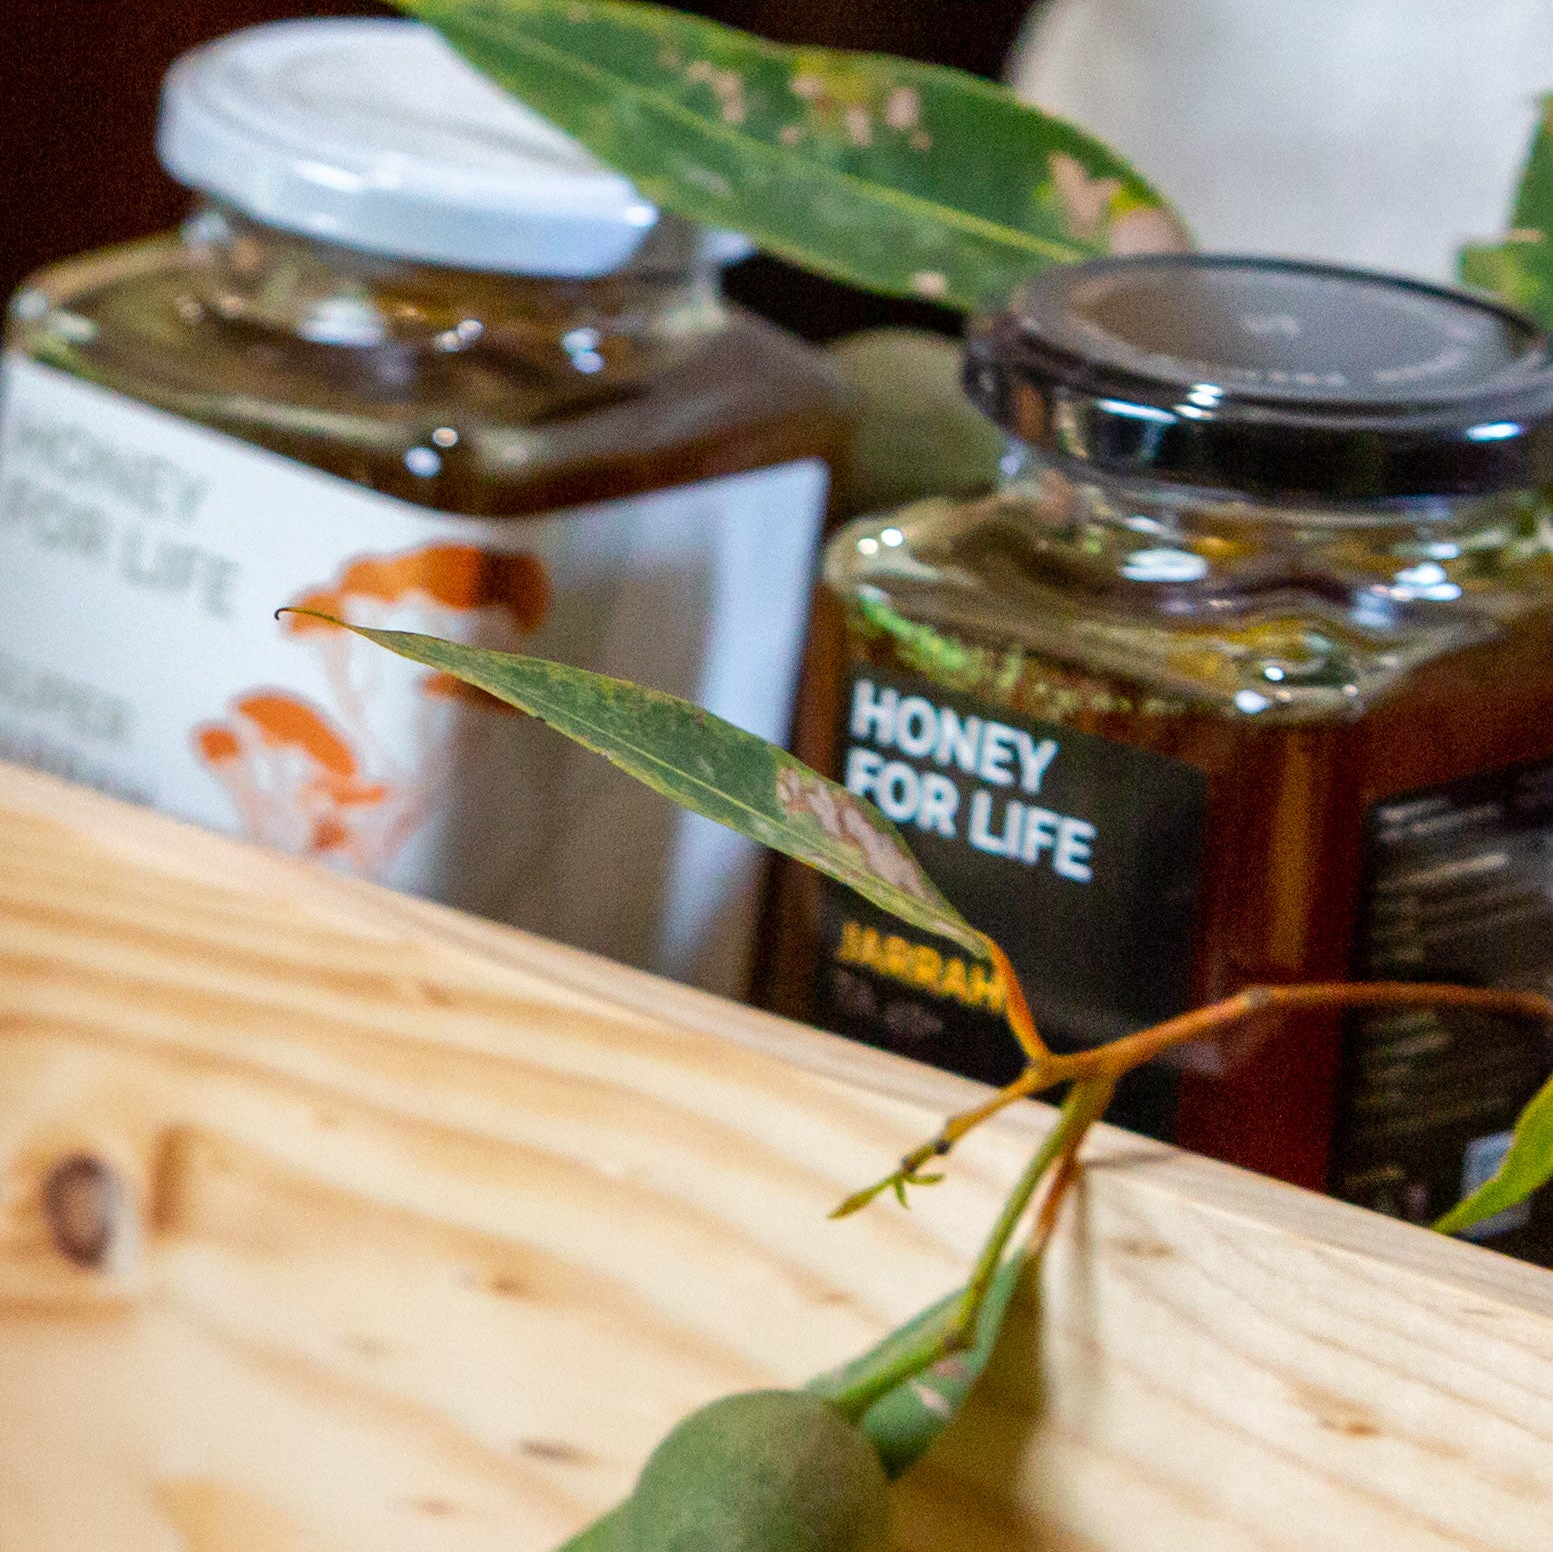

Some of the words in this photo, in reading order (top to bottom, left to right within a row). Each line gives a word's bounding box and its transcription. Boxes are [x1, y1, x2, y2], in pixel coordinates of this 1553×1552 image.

[851, 679, 1059, 795] HONEY
[846, 746, 957, 838] FOR
[968, 790, 1097, 882] LIFE
